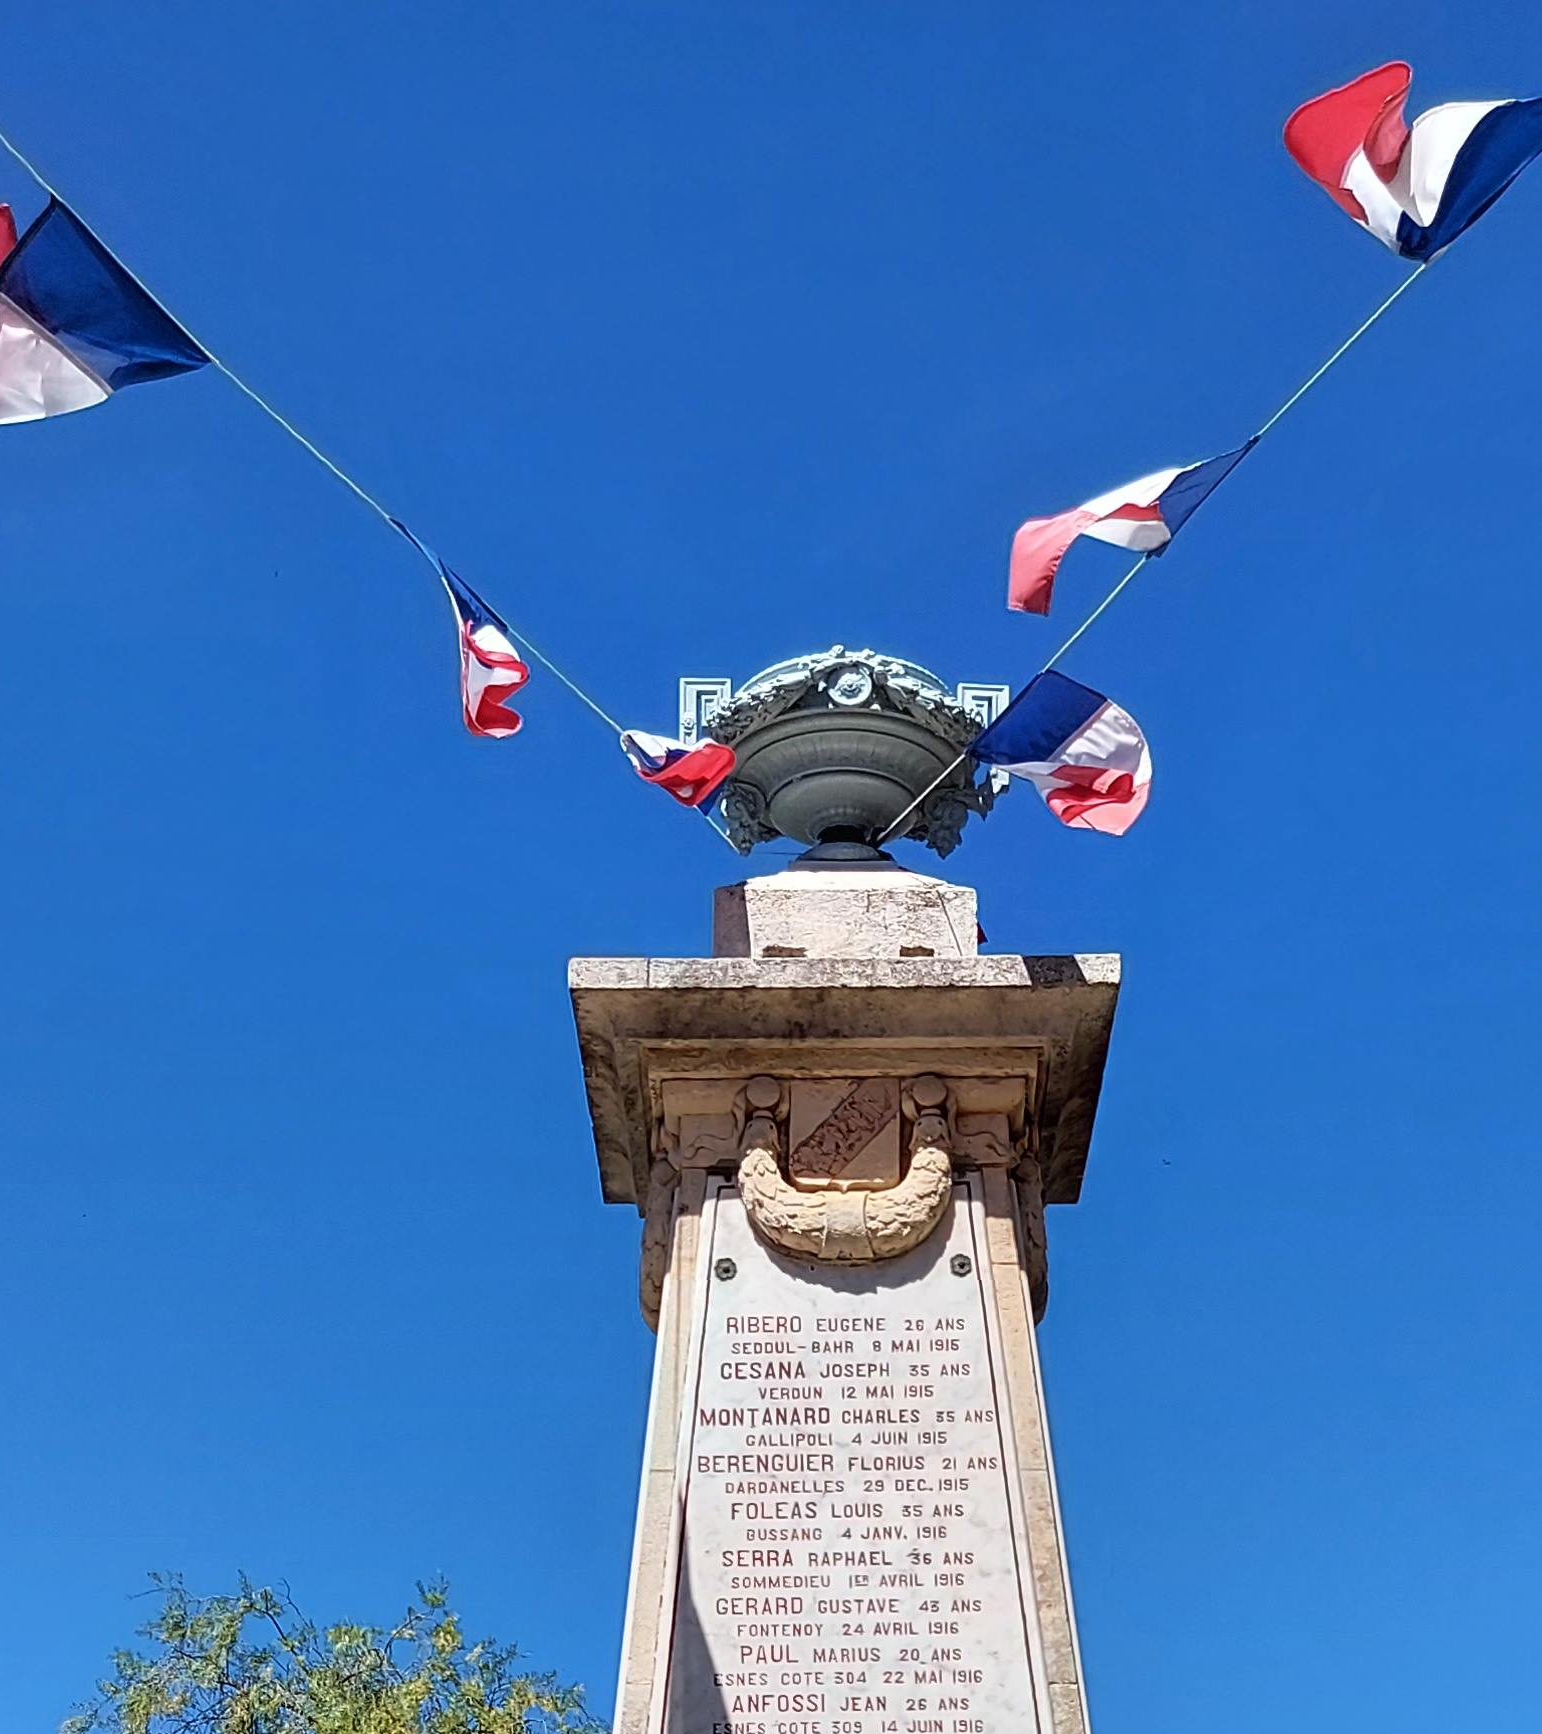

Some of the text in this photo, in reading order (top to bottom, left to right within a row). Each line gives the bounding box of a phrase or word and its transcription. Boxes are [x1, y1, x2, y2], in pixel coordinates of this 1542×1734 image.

[727, 1316, 801, 1334] RIBERO
[816, 1317, 885, 1332] EUGENE
[935, 1318, 964, 1331] ANS
[873, 1340, 881, 1352] 8
[891, 1339, 920, 1352] MAI
[930, 1338, 959, 1351] 1915
[721, 1361, 970, 1380] CESANA JOSEPH 35 ANS
[758, 1385, 933, 1400] VERDUN 12 MAI 1915
[700, 1407, 830, 1428] MONTANARD
[842, 1409, 920, 1424] CHARLES
[965, 1410, 993, 1422] ANS
[746, 1431, 947, 1447] GALLIPOLI 4 JUIN 1915
[698, 1455, 997, 1473] BERENGUIER FLORIUS 21 ANS
[726, 1480, 845, 1494] DARDANELLES
[864, 1480, 884, 1492] 29
[939, 1478, 969, 1491] 1915
[731, 1502, 964, 1520] FOLEAS LOUIS 35 ANS
[747, 1526, 947, 1541] BUSSANG 4 JANV. 1916
[722, 1549, 793, 1567] SERRA
[808, 1551, 893, 1567] RAPHAEL
[943, 1552, 974, 1565] ANS
[731, 1576, 830, 1589] SOMMEDIEU
[879, 1573, 924, 1587] AVRIL
[934, 1573, 964, 1586] 1916
[716, 1597, 802, 1615] GERARD
[818, 1599, 899, 1614] GUSTAVE
[951, 1600, 981, 1612] ANS
[738, 1622, 959, 1637] FONTENOY 24 AVRIL 1916
[740, 1644, 961, 1664] PAUL MARIUS 20 ANS
[714, 1670, 982, 1686] ESNES COTE 304 22 MAI 1916
[732, 1694, 969, 1713] ANFOSSI JEAN 26 ANS
[713, 1722, 765, 1734] ESNES
[778, 1721, 820, 1734] COTE
[882, 1721, 898, 1732] 14
[907, 1720, 943, 1733] JUIN
[953, 1720, 983, 1733] 1916
